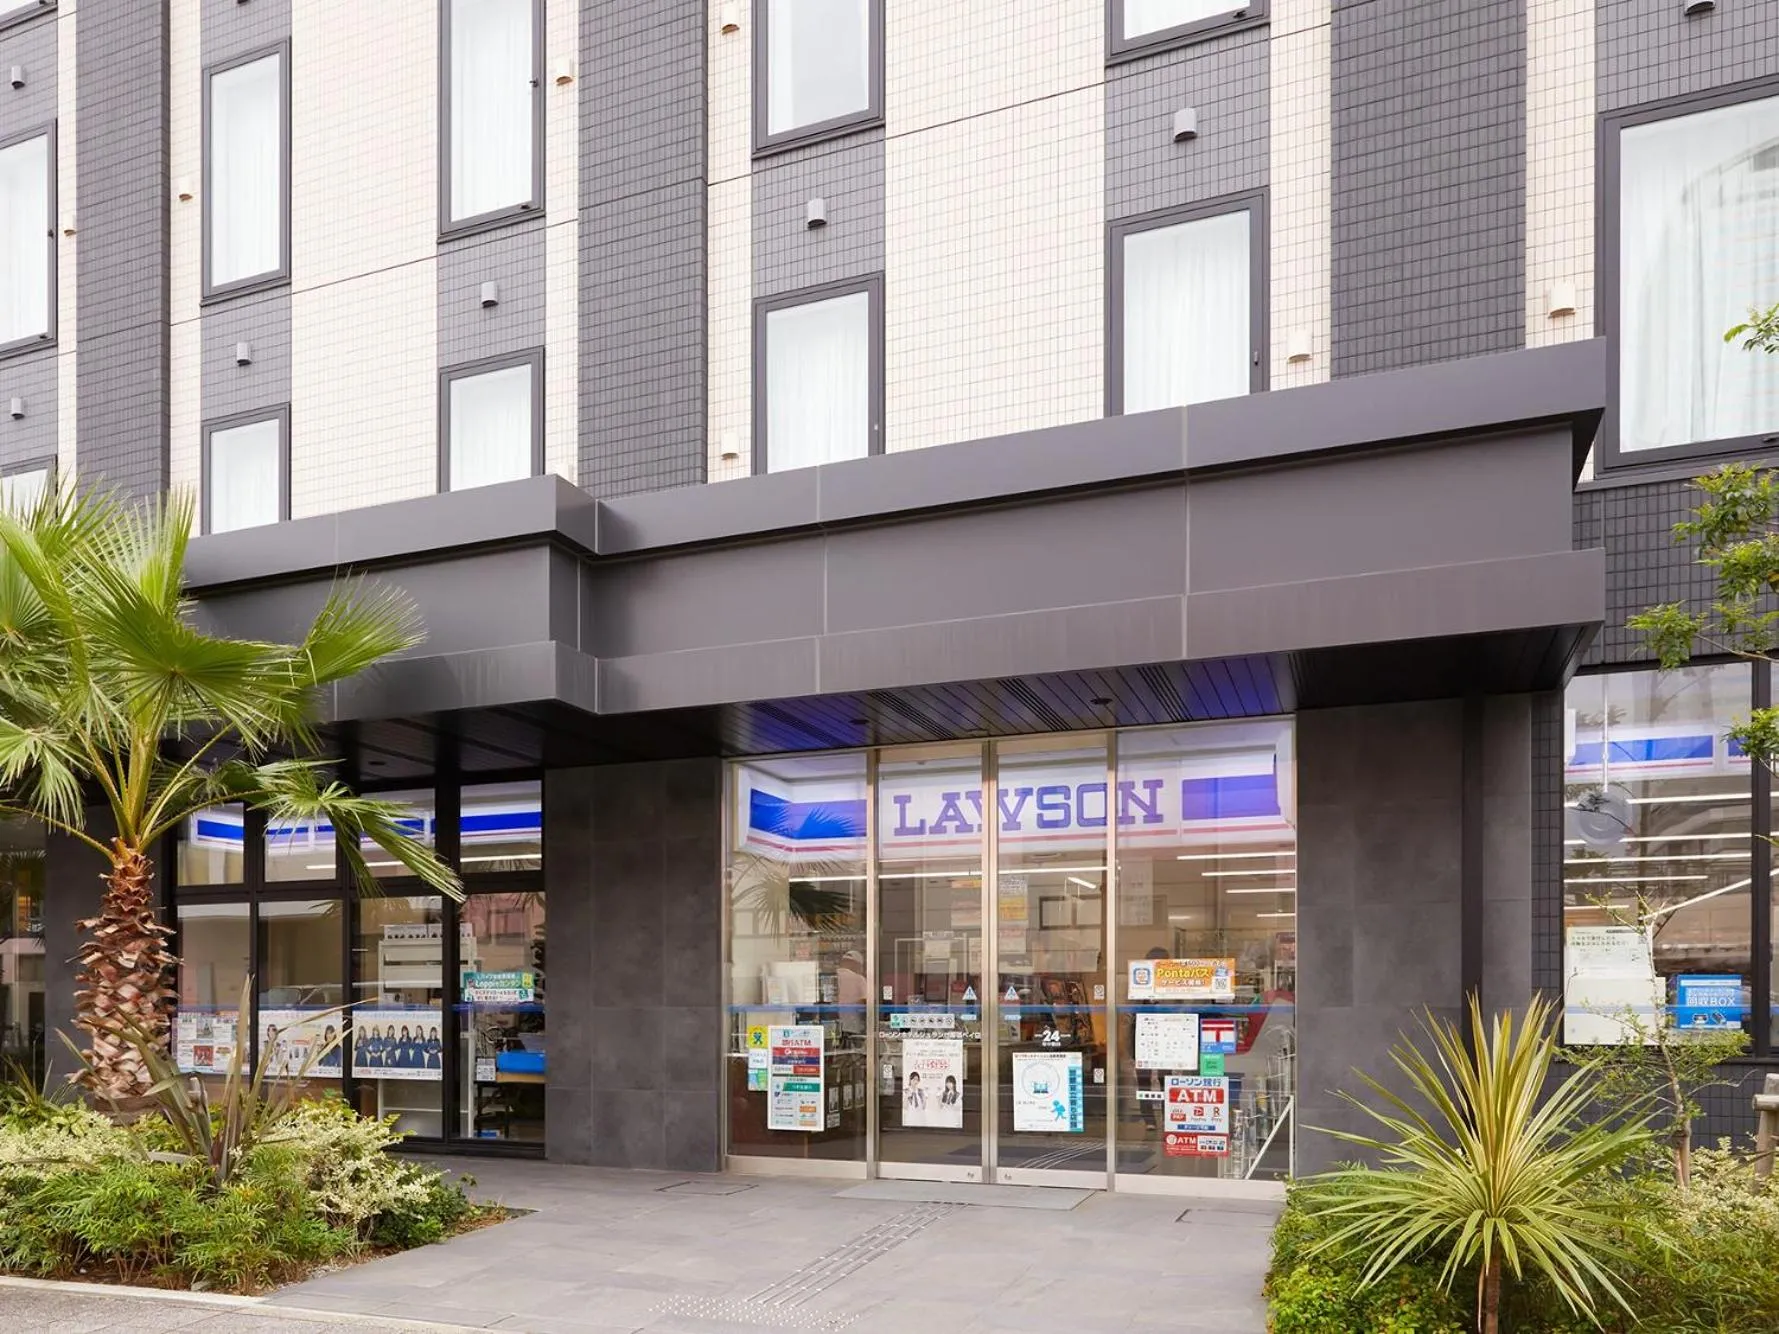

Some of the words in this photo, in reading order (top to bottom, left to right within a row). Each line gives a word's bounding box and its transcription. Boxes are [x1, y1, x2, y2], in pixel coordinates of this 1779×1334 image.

[893, 779, 1164, 837] LAWSON
[1156, 967, 1210, 979] Pontaパス
[1042, 1030, 1061, 1042] 24
[1171, 1078, 1221, 1087] ローソン銀行
[1177, 1089, 1217, 1103] ATM
[1177, 1136, 1196, 1144] ATM
